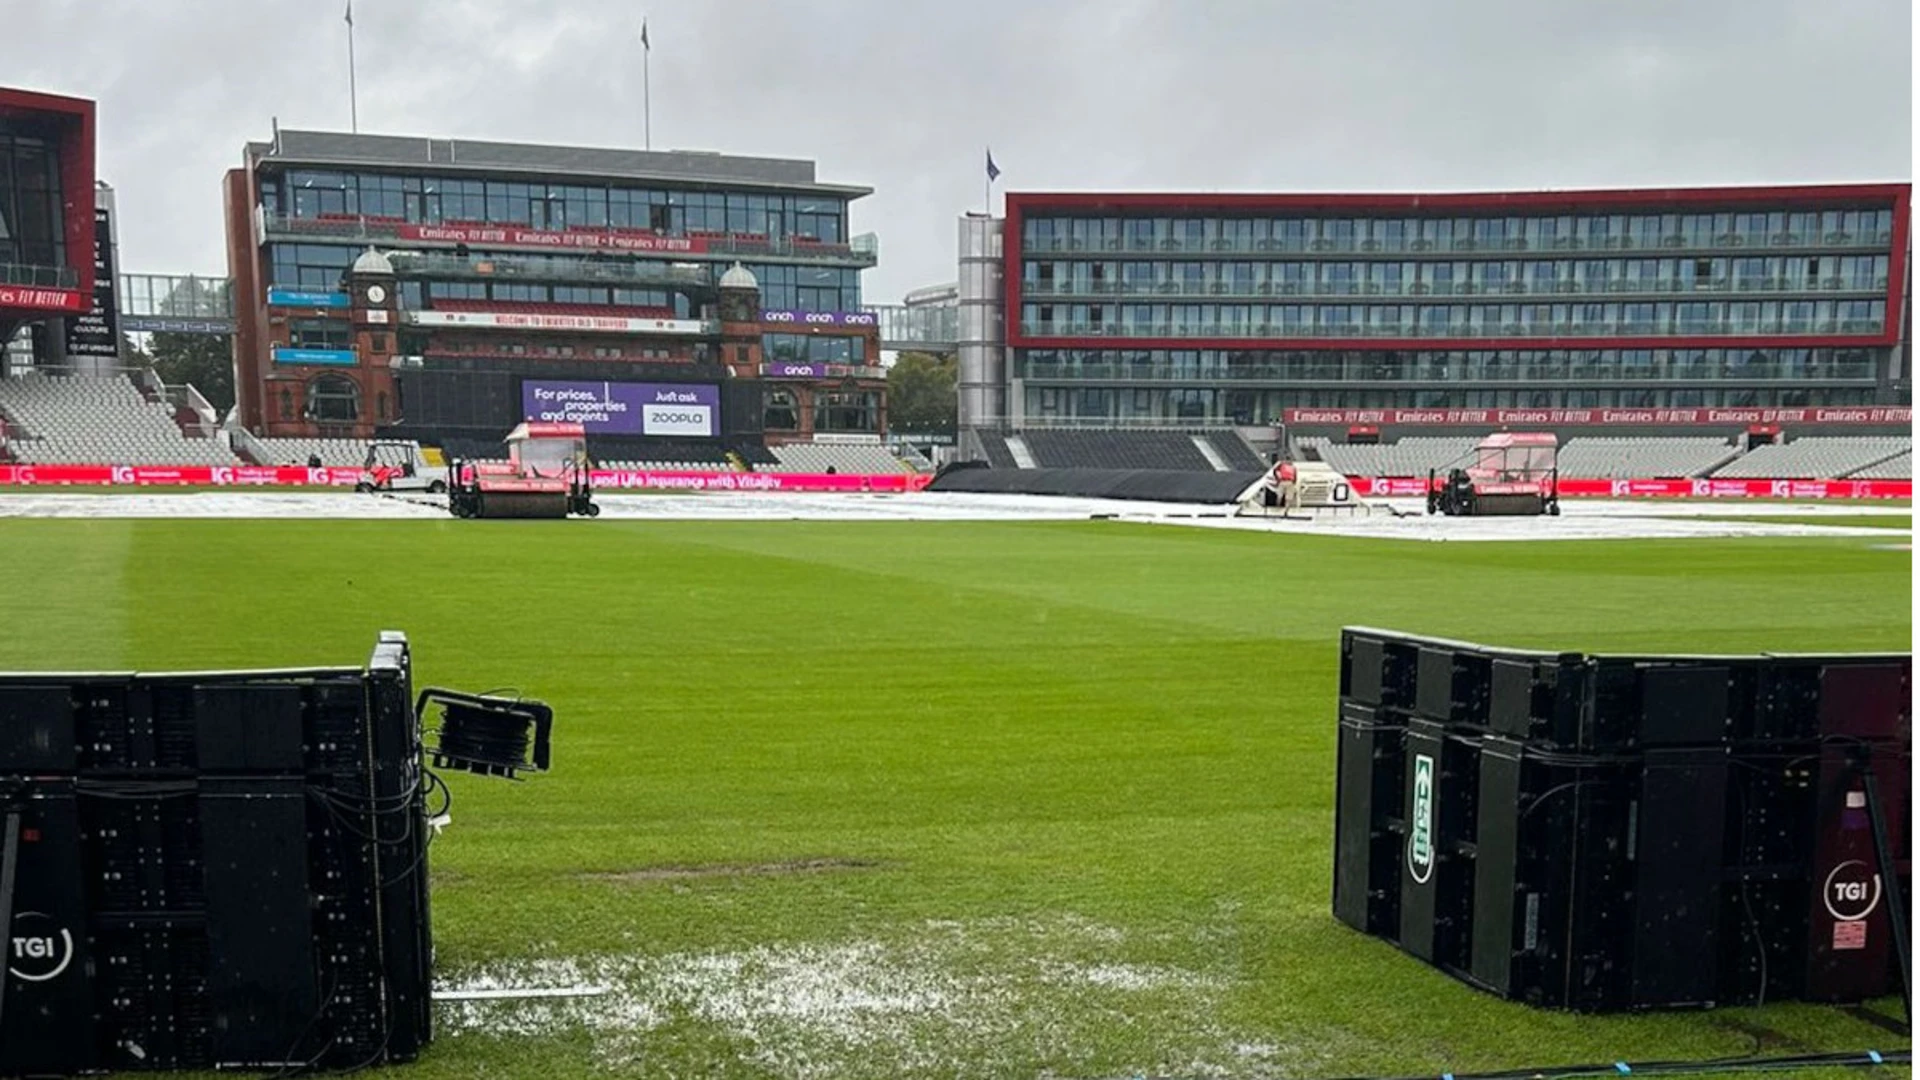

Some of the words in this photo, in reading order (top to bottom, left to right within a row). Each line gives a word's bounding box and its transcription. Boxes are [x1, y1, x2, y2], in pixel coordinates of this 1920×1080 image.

[420, 226, 466, 240] Emirates
[515, 231, 560, 244] Emirates
[609, 235, 653, 248] Emirates
[0, 291, 14, 303] es
[766, 311, 795, 322] cinch
[806, 312, 834, 323] cinch
[845, 313, 873, 324] cinch
[784, 365, 813, 376] cinch
[534, 389, 555, 400] For
[556, 388, 597, 402] prices,
[656, 391, 677, 402] Just
[678, 392, 698, 402] ask
[565, 400, 627, 412] properties
[541, 410, 565, 421] and
[567, 411, 610, 422] agents
[1294, 410, 1342, 422] Emirates
[1396, 410, 1444, 422] Emirates
[1499, 410, 1548, 422] Emirates
[1603, 410, 1653, 422] Emirates
[1709, 410, 1760, 421] Emirates
[1816, 409, 1868, 421] Emirates
[111, 466, 135, 483] IG
[211, 466, 233, 483] IG
[308, 466, 329, 483] IG
[594, 475, 618, 485] and
[621, 475, 645, 486] Life
[707, 475, 736, 487] with
[737, 475, 782, 488] Vitality
[1371, 479, 1389, 494] IG
[1612, 480, 1630, 496] IG
[1693, 480, 1711, 496] IG
[1771, 480, 1790, 497] IG
[1834, 882, 1868, 901] TGI
[12, 937, 54, 957] TGI
